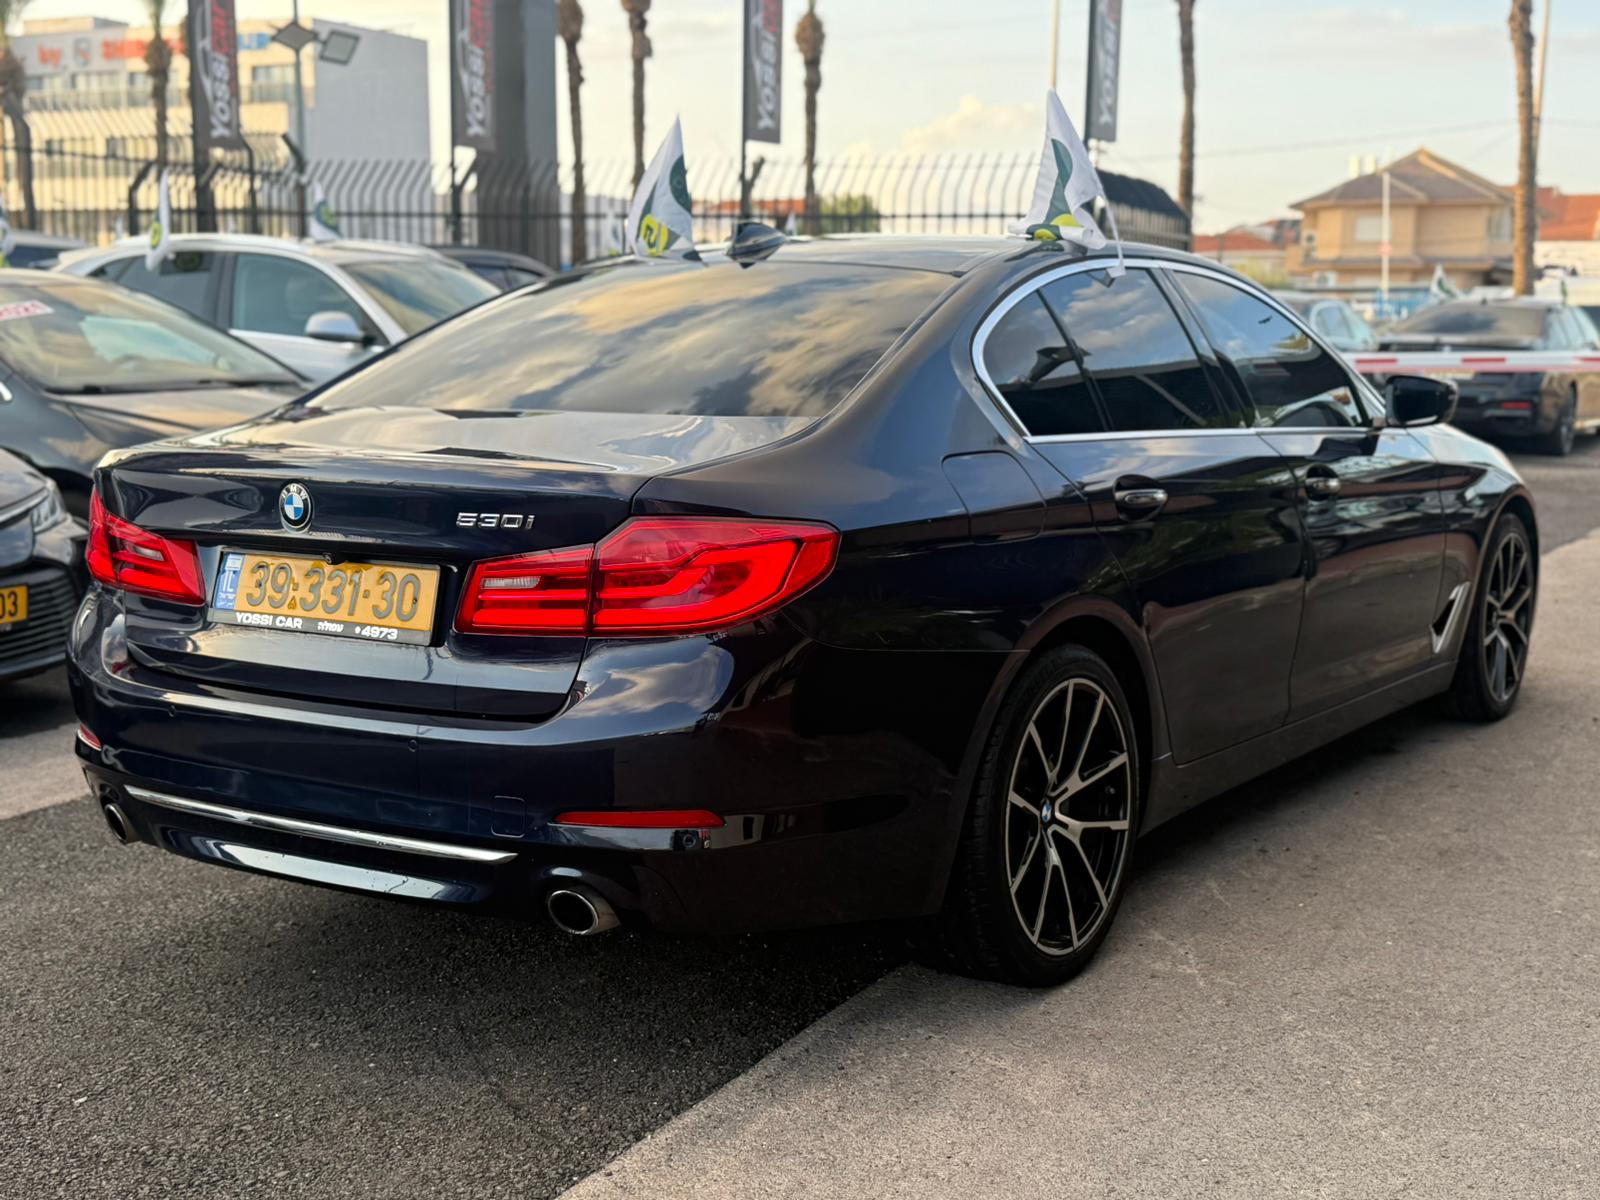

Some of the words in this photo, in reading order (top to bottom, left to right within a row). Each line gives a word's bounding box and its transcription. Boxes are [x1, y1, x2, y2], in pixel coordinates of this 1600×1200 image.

[207, 51, 231, 138] YOSSI
[466, 46, 486, 136] YOSSI
[757, 31, 777, 129] YOSSI
[281, 484, 308, 501] BMW
[456, 512, 535, 529] 530i
[235, 611, 273, 626] YOSSI
[275, 616, 303, 629] CAR
